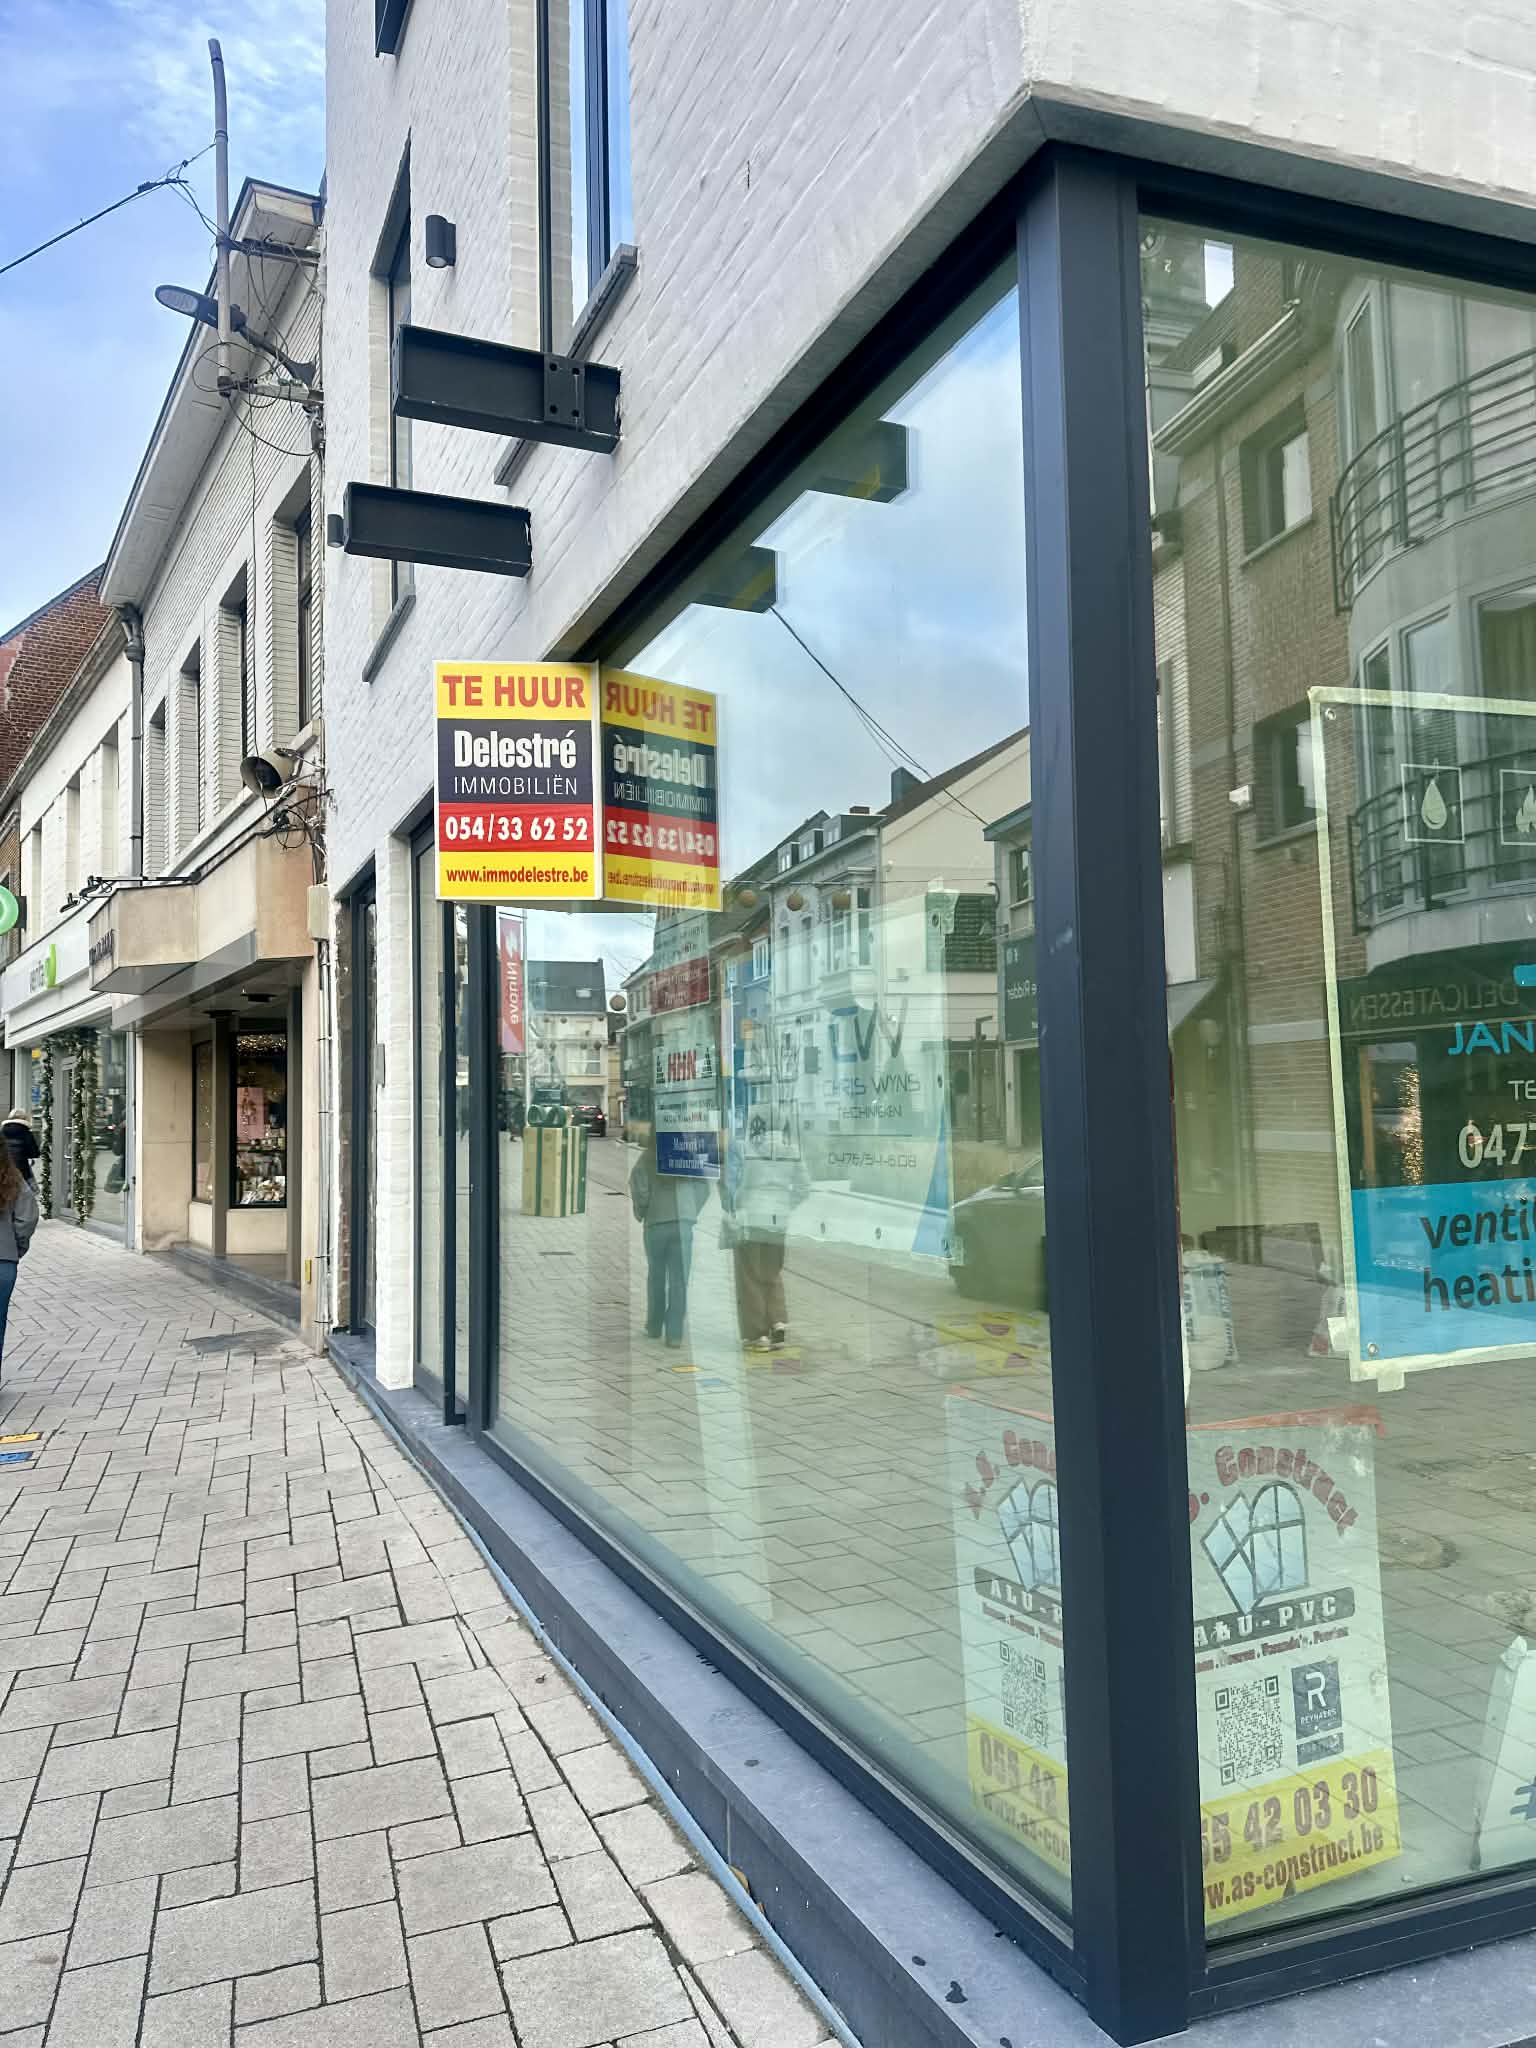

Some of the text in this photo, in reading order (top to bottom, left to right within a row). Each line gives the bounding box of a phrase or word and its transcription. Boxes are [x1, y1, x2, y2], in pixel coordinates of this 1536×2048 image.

[442, 675, 586, 708] TE HUUR
[454, 729, 577, 769] Delestré
[454, 774, 578, 796] IMMOBILIËN
[445, 813, 588, 843] 054/33 62 52
[446, 865, 589, 885] www.immodelestre.be
[1448, 1021, 1536, 1055] JAN
[1294, 1780, 1332, 1837] 03
[1341, 1766, 1379, 1821] 30
